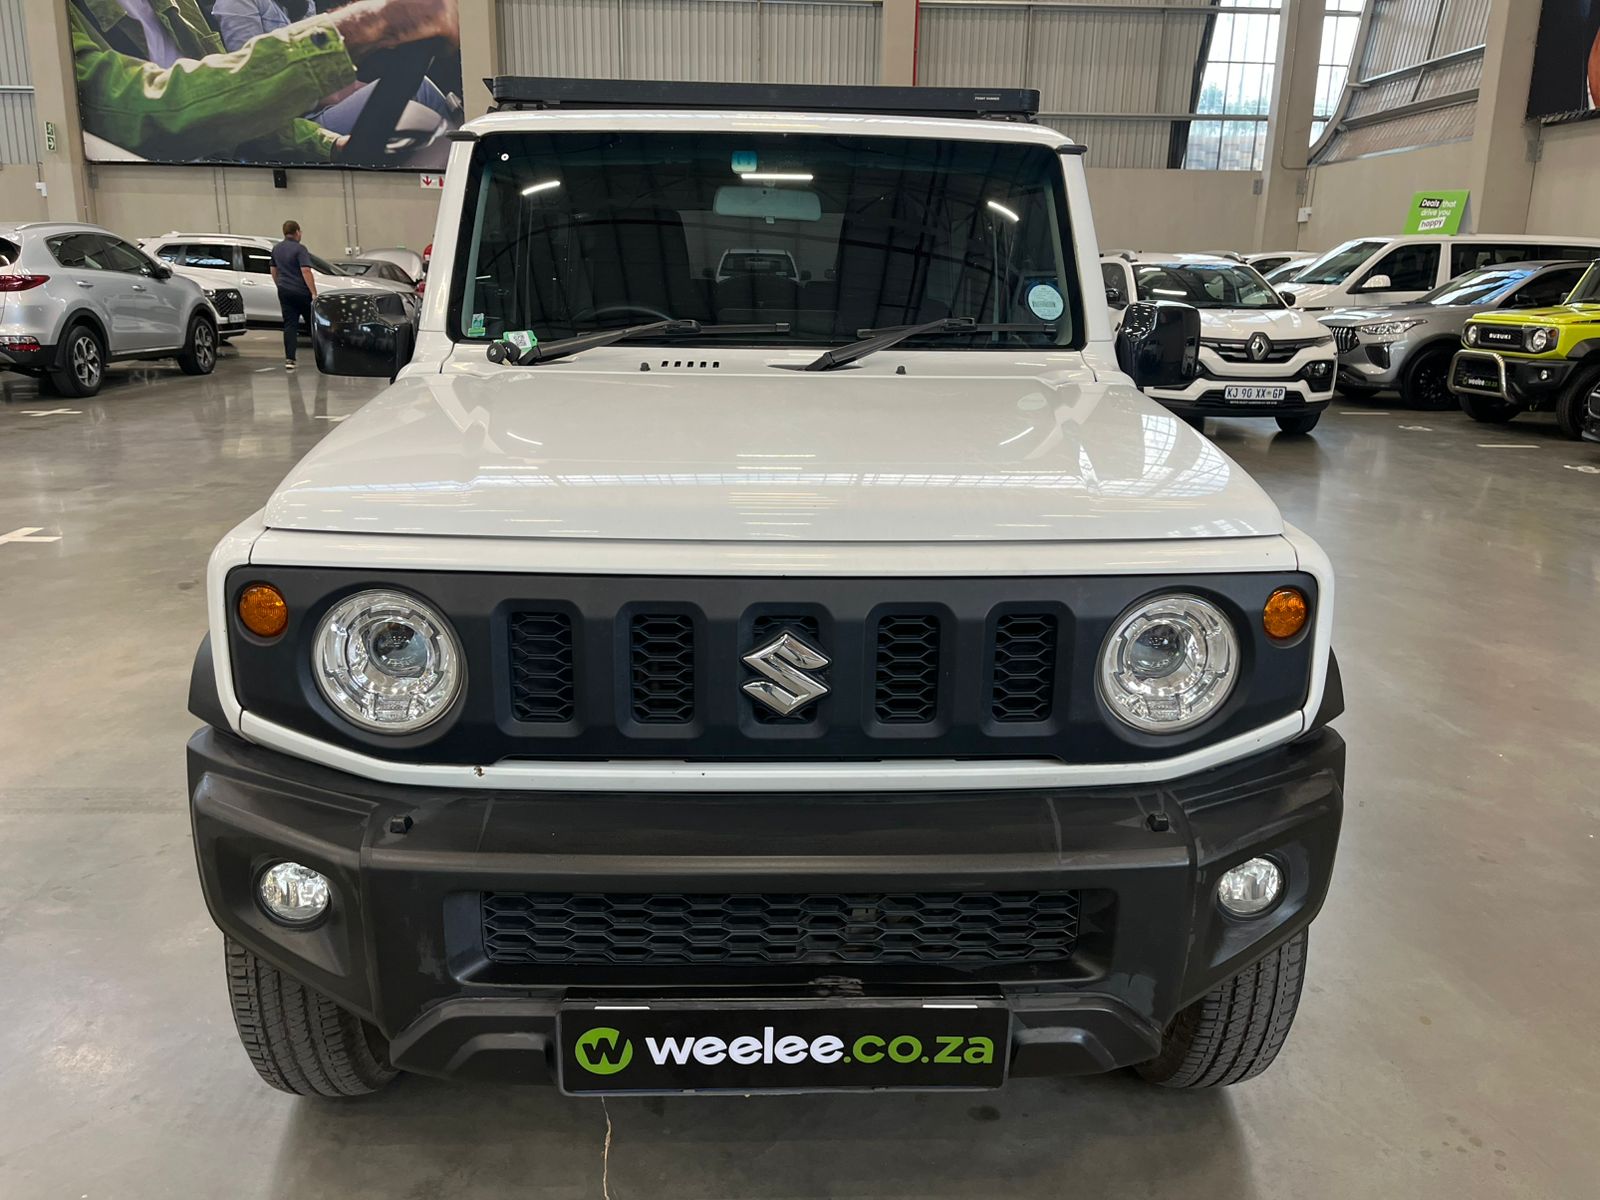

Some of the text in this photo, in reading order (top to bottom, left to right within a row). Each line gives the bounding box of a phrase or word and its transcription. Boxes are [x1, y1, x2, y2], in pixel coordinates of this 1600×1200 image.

[1421, 199, 1457, 208] Deals that
[1420, 208, 1452, 218] drive you
[1421, 219, 1443, 229] happy
[1226, 387, 1284, 399] KJ 90 XX GP
[645, 1026, 995, 1066] weelee.co.za
